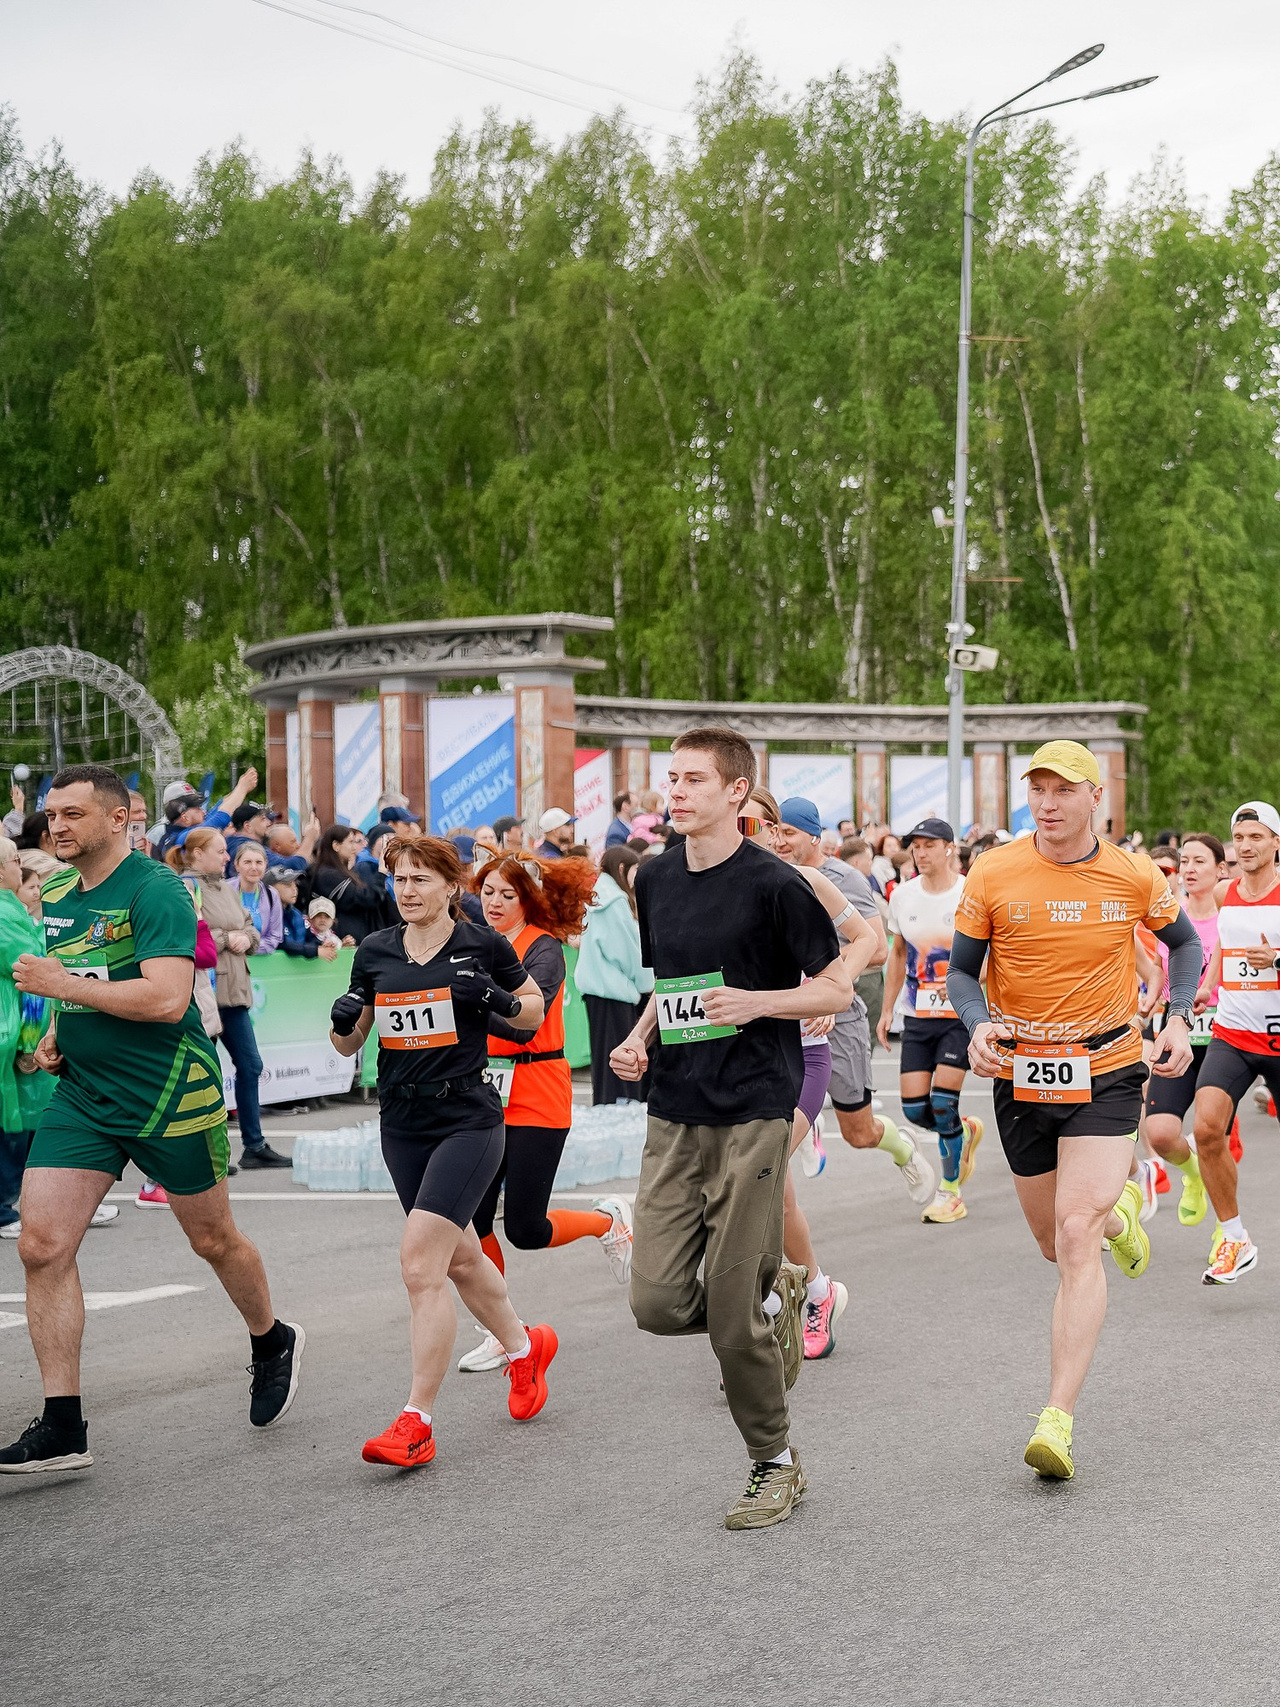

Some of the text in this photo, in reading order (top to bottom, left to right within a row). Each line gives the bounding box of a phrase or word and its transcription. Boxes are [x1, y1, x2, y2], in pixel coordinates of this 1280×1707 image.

[440, 742, 512, 809] ДВИЖЕНИЕ
[574, 776, 602, 798] ЕНИЕ
[437, 767, 514, 836] ПЕРВЫХ
[1045, 901, 1087, 910] TYUMEN
[1101, 902, 1120, 910] MAN
[1050, 911, 1082, 922] 2025
[1101, 911, 1127, 922] STAR
[389, 1007, 435, 1032] 311
[681, 1029, 707, 1040] 4,2км
[404, 1038, 430, 1047] 21,1км
[1026, 1061, 1073, 1085] 250
[1038, 1090, 1063, 1101] 21,1км
